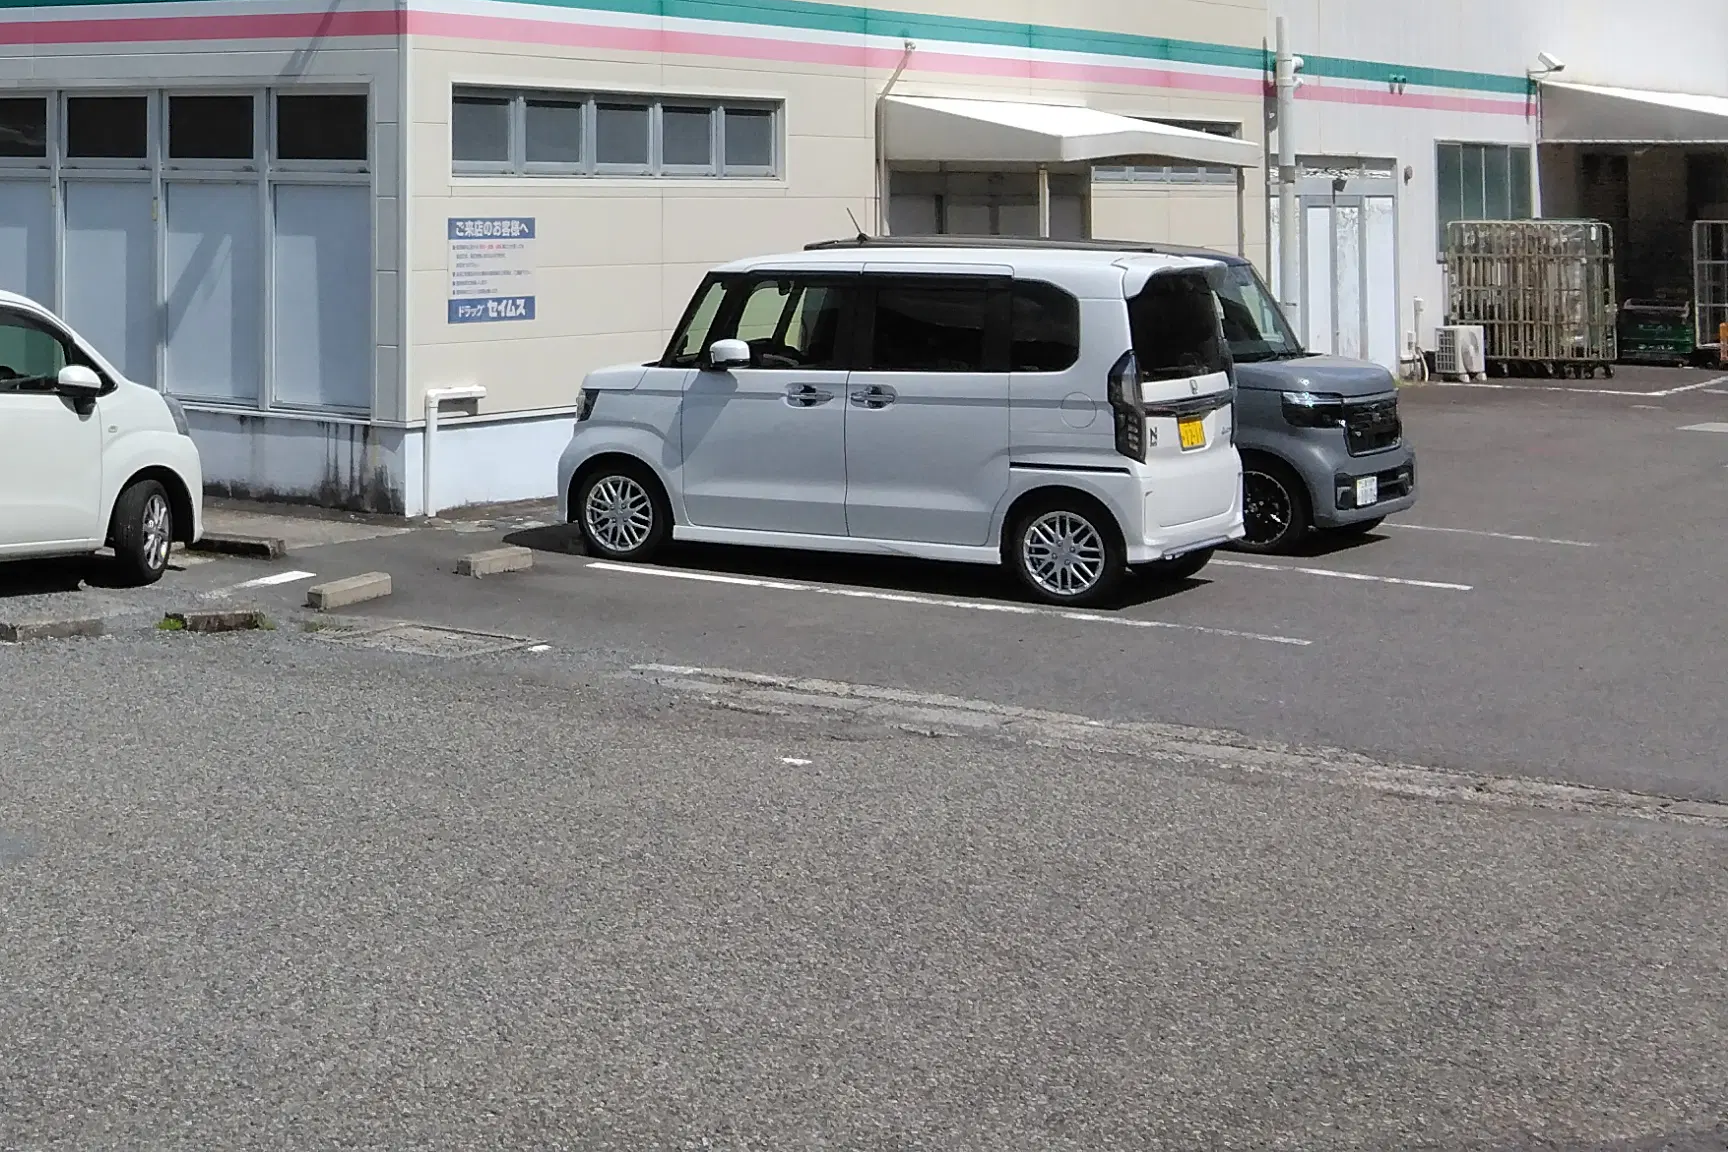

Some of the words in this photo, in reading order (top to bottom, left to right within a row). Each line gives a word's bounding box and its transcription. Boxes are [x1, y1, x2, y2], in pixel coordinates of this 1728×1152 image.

[456, 220, 529, 237] ご来店のお客様へ
[458, 305, 485, 318] ドラッグ
[487, 299, 526, 317] セイムス
